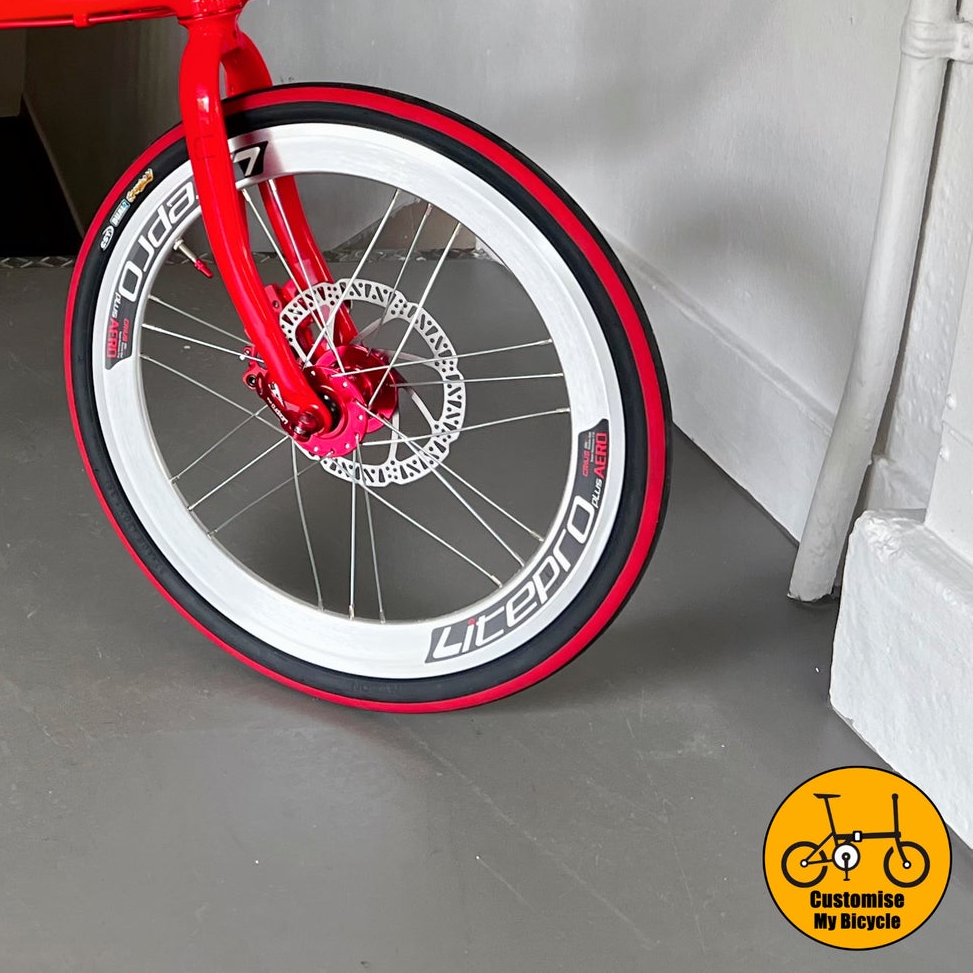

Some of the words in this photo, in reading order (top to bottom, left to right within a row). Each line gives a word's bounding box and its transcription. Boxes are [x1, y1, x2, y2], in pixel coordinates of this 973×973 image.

[106, 317, 120, 358] AERO
[593, 432, 608, 479] AERO
[591, 478, 603, 508] plus
[432, 495, 595, 659] Litepro
